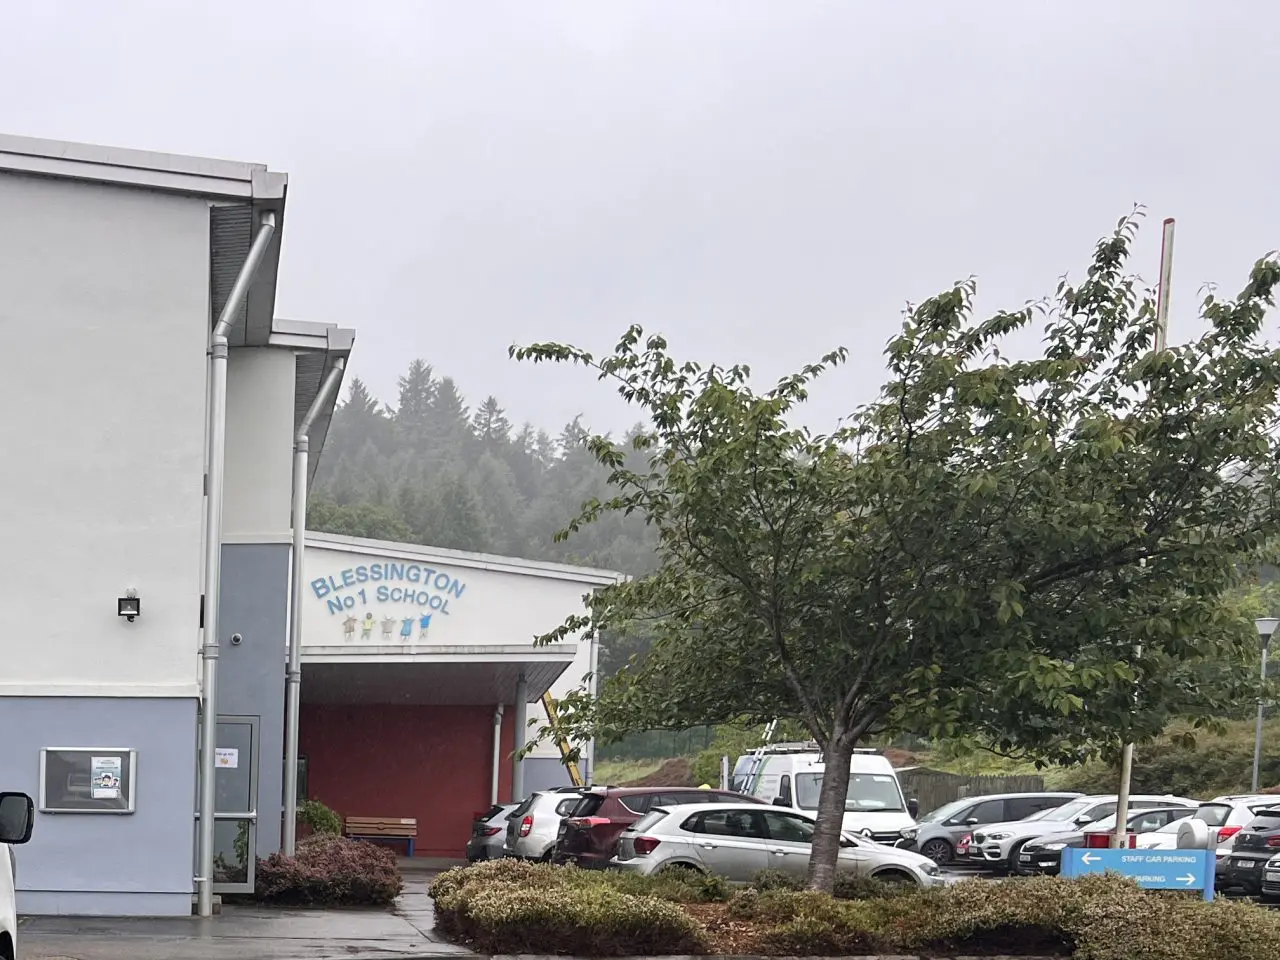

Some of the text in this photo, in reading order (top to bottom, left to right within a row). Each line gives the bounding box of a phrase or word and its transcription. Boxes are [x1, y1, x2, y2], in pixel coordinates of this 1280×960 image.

[310, 563, 466, 599] BLESSINGTON
[358, 588, 367, 605] 1
[376, 585, 450, 615] SCHOOL
[1121, 855, 1197, 863] STAFF CAR PARKING
